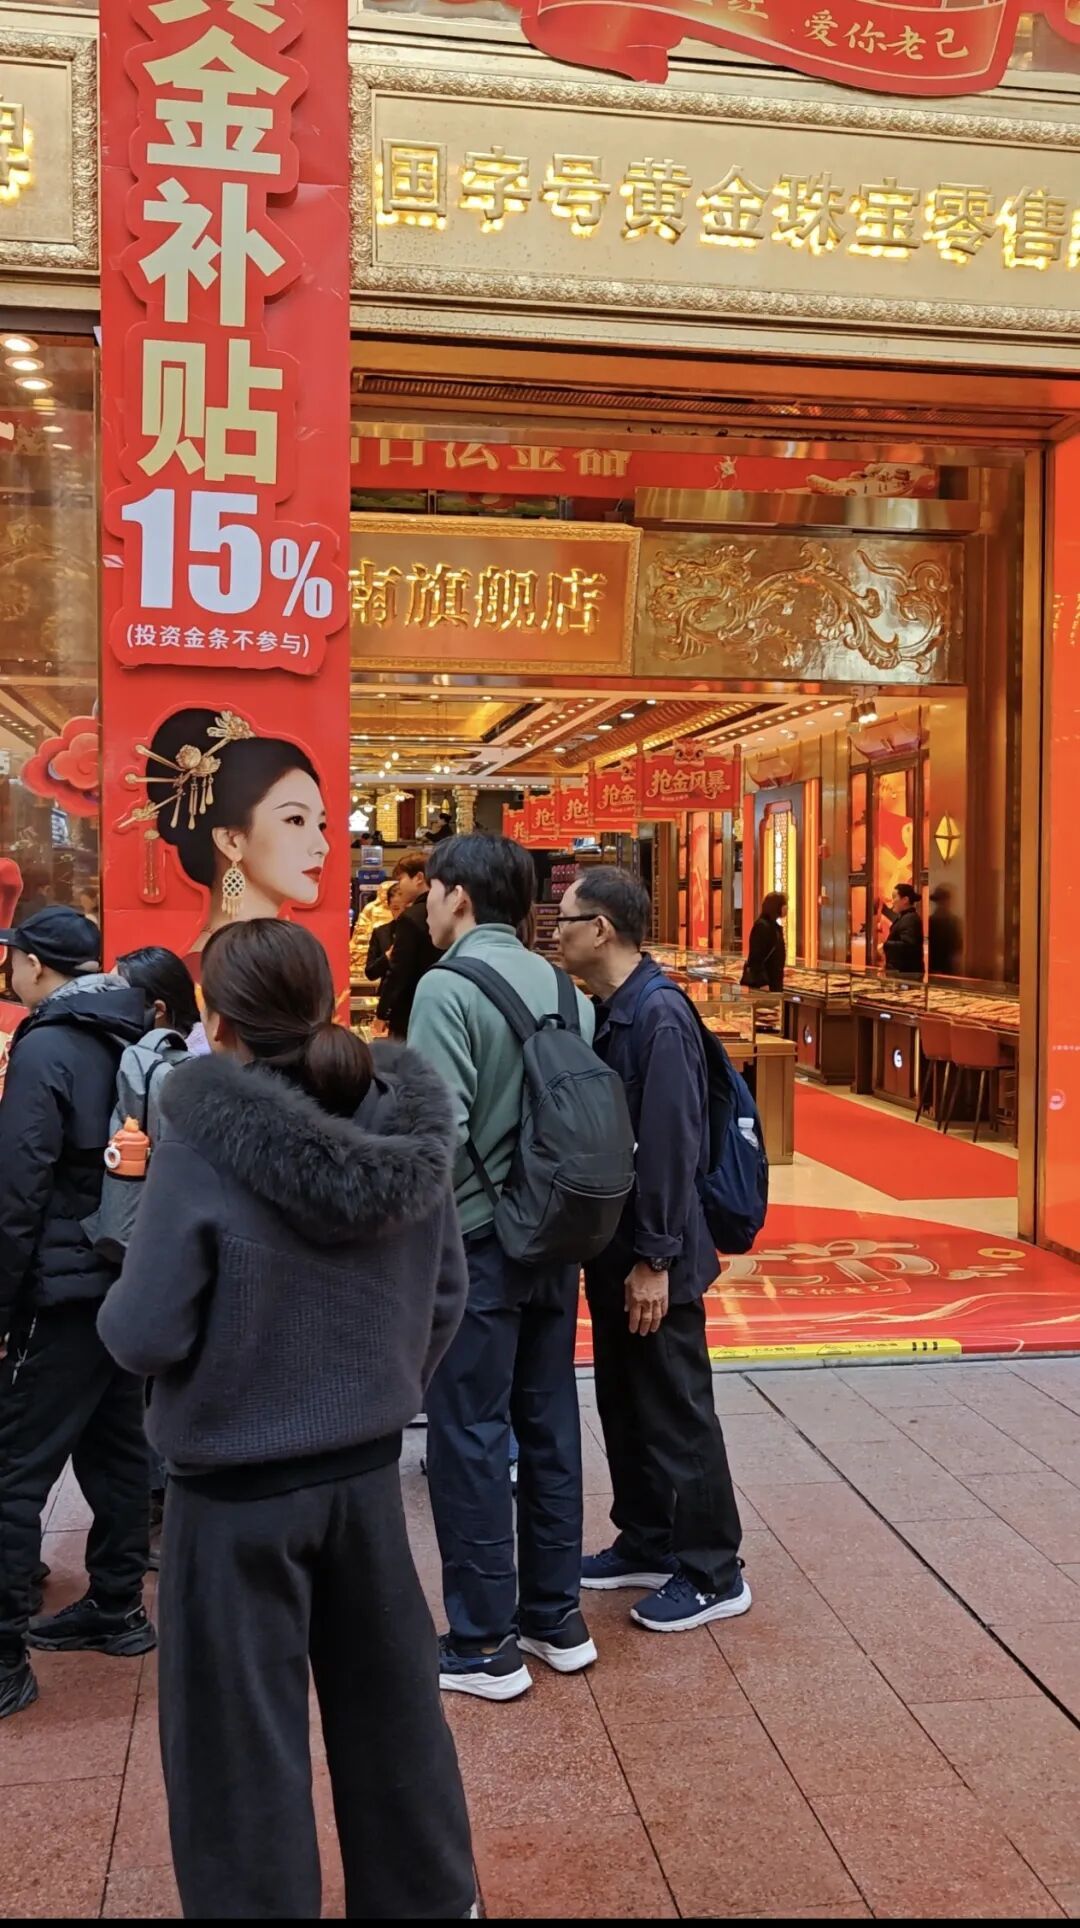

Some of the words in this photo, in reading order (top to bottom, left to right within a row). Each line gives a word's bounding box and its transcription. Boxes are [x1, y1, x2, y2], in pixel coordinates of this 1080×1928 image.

[804, 9, 969, 61] 爱你老己
[137, 0, 291, 485] 金补贴
[379, 137, 1080, 268] 国字号黄金珠宝零售
[121, 488, 333, 619] 15%
[126, 623, 310, 658] (投资金条不参与)
[645, 768, 731, 800] 抢金风暴
